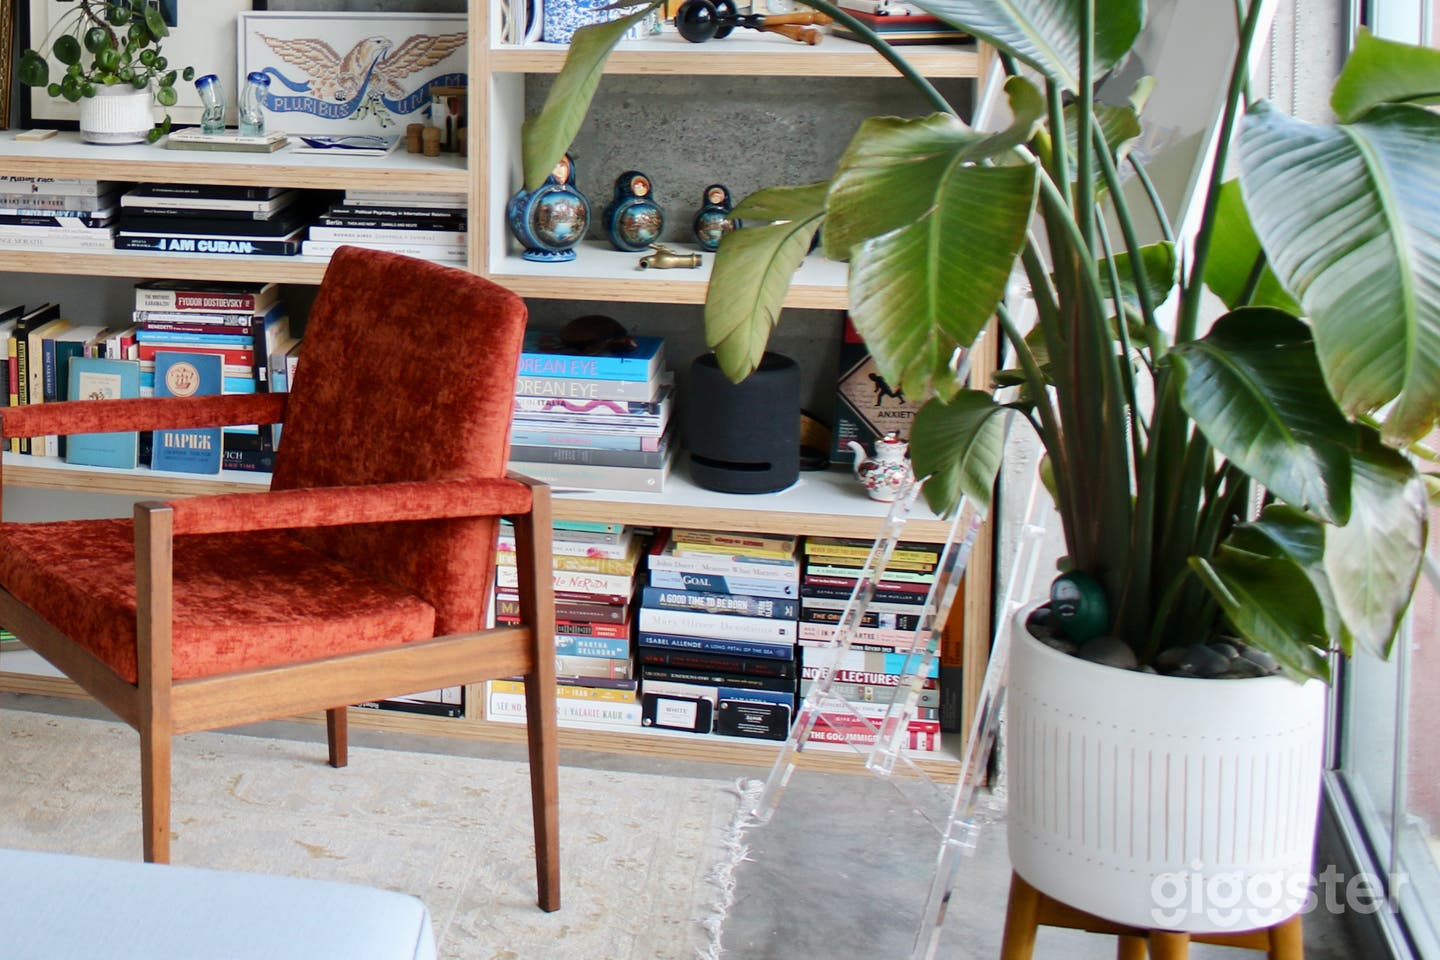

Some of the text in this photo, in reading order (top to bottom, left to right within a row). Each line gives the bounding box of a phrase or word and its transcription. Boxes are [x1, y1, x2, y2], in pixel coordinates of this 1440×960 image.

[274, 97, 349, 117] PLURIBUS
[372, 209, 397, 217] Psychology
[169, 239, 195, 251] AM
[197, 240, 252, 253] CUBAN
[178, 296, 243, 308] FYODOR DOSTOEVSKY
[569, 359, 598, 376] EYE
[45, 364, 53, 394] SARAMAGO
[570, 381, 598, 397] EYE
[537, 399, 566, 407] ITALIA
[164, 432, 211, 450] ПАРИЖ
[683, 575, 711, 586] GOAL
[667, 593, 686, 604] GOOD
[688, 595, 706, 606] TIME
[706, 597, 715, 607] TO
[716, 597, 726, 608] BE
[727, 598, 748, 610] BORN
[651, 615, 676, 628] Mary
[681, 618, 714, 629] Oliver
[646, 637, 669, 646] ISABEL
[672, 639, 702, 648] ALLENDE
[578, 647, 616, 656] GELLHORN
[842, 670, 900, 686] LECTURES
[497, 702, 622, 720] SEE NO VALARIE KAUR
[665, 706, 688, 714] WHITE
[810, 731, 825, 740] THE
